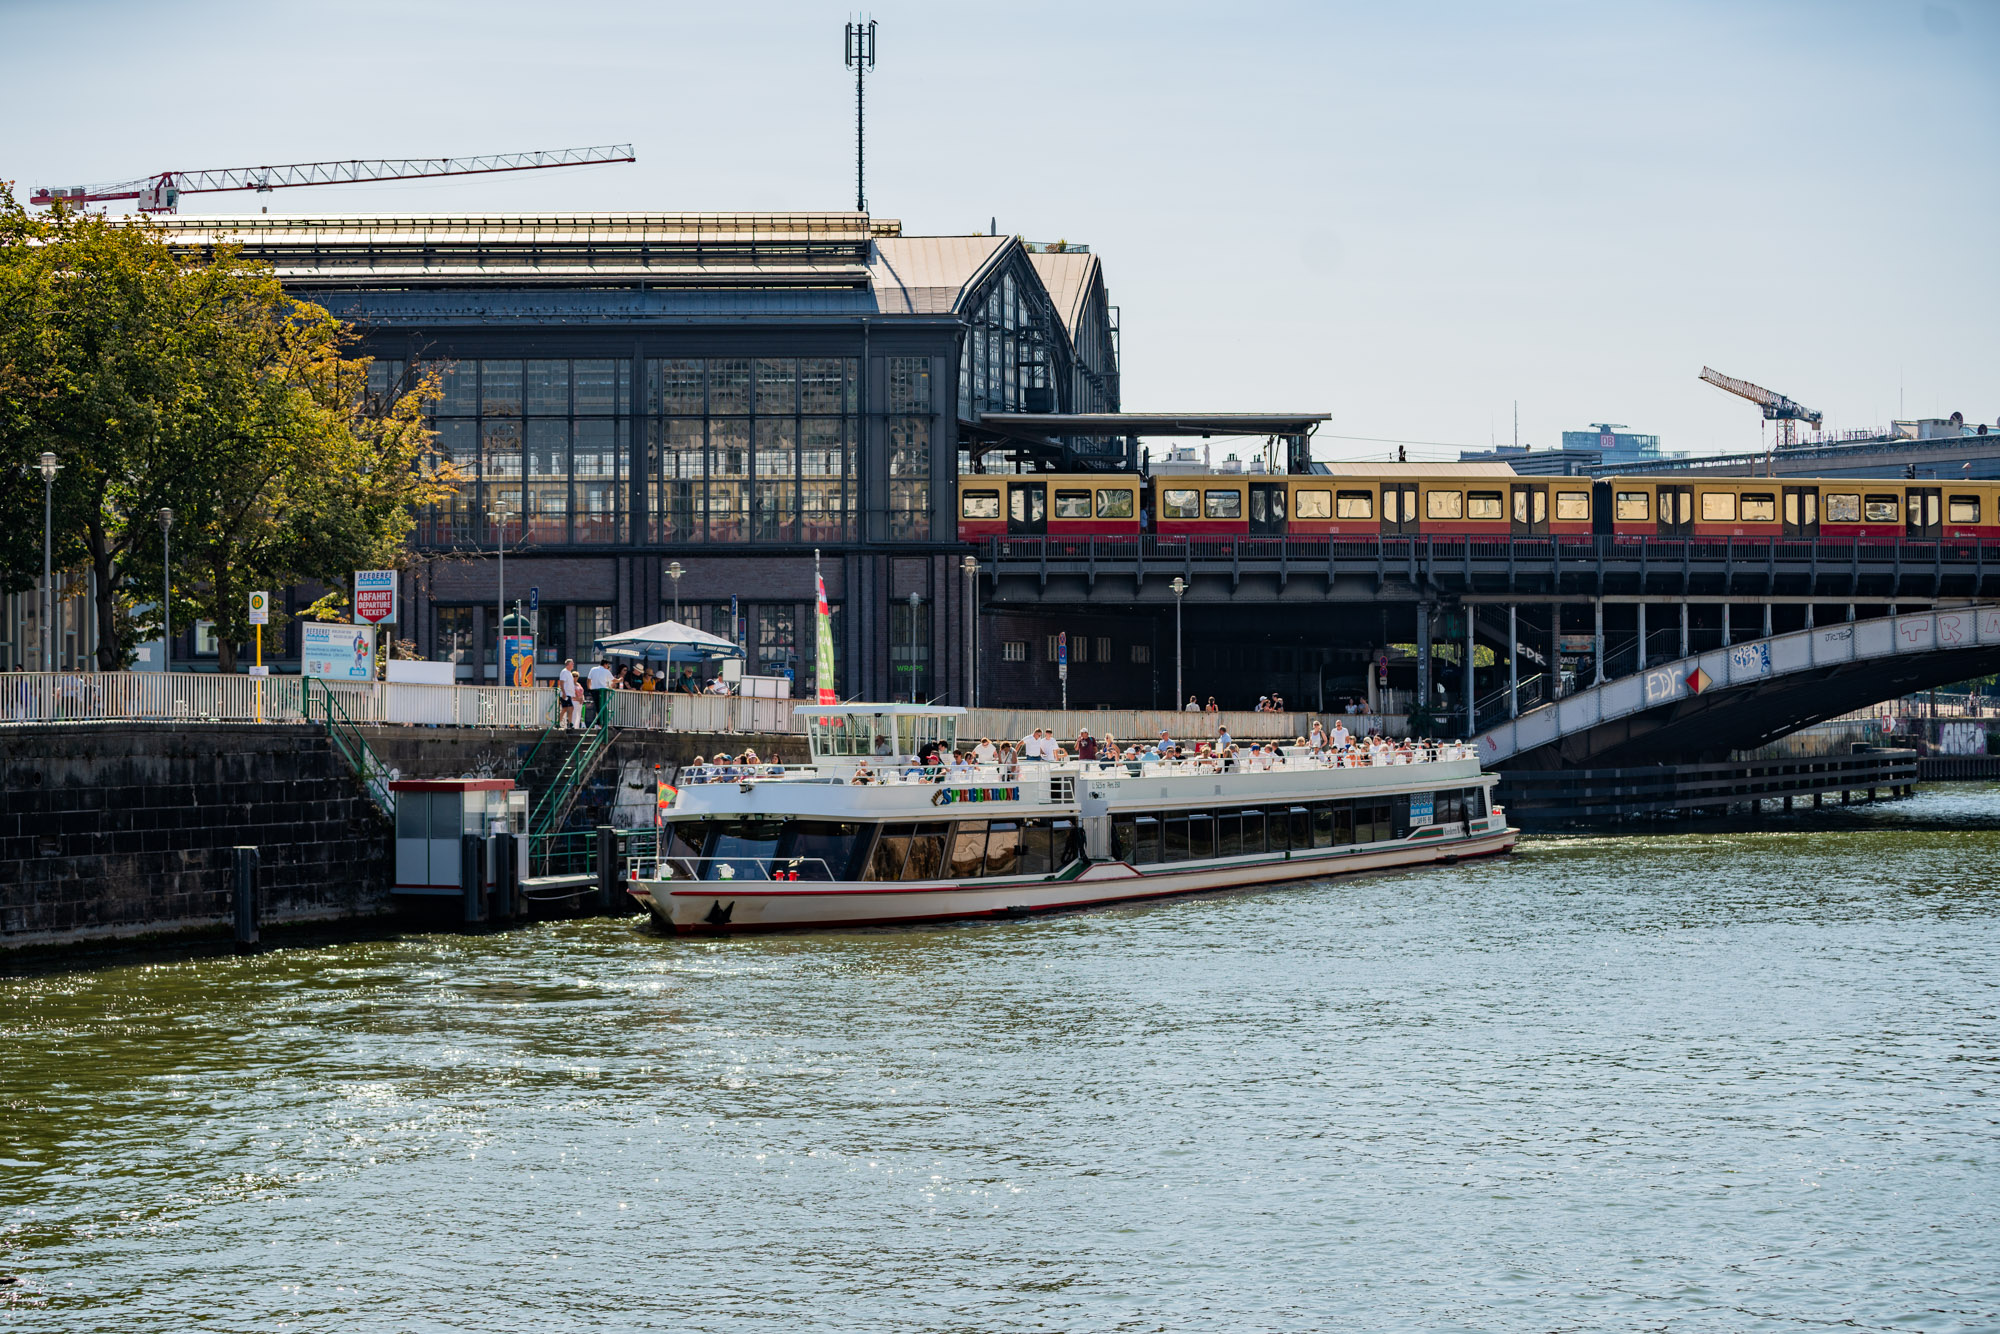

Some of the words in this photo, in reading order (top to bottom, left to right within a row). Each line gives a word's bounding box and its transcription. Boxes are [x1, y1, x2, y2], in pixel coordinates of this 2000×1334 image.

[1602, 436, 1614, 446] DB
[359, 592, 391, 601] ABFAHRT
[532, 591, 536, 600] P
[359, 601, 391, 609] DEPARTURE
[1516, 642, 1546, 666] EDR
[942, 786, 1020, 804] SPREEKRONE
